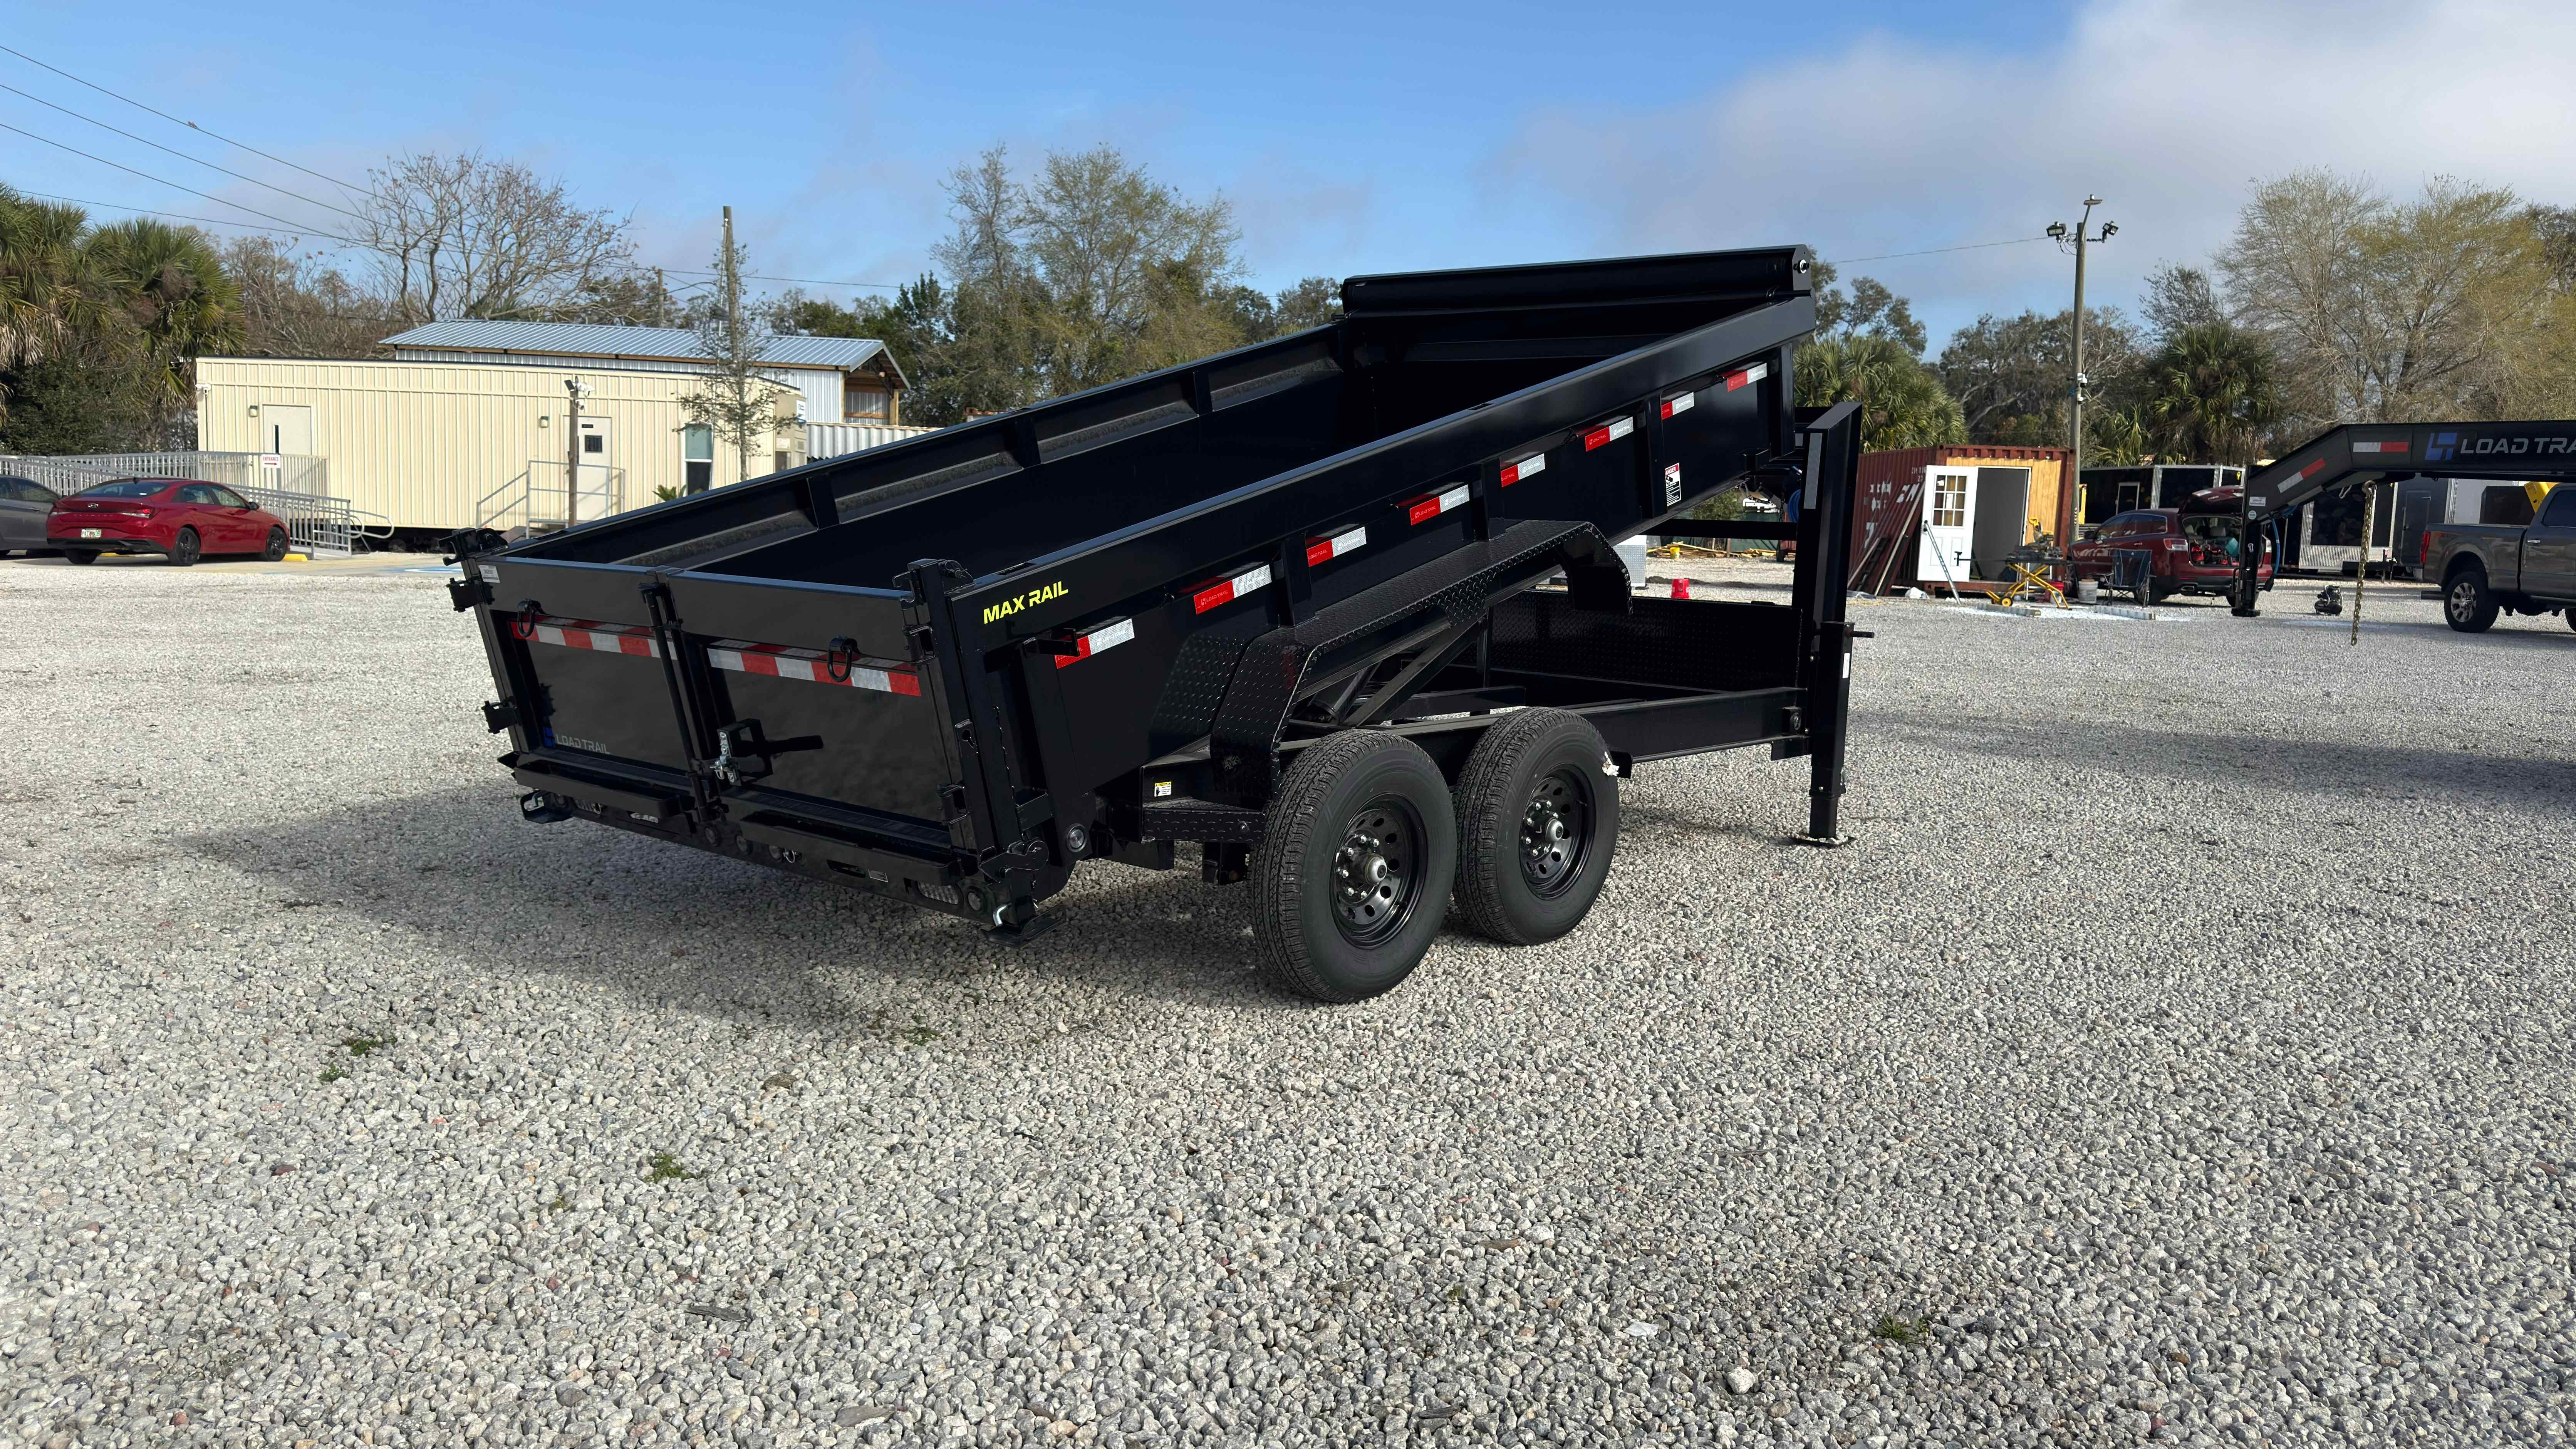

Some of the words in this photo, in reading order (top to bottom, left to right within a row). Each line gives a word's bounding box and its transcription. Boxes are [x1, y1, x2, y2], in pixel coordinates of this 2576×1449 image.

[2460, 438, 2529, 454] LOAD
[1665, 466, 1676, 475] ANGER
[1217, 590, 1228, 598] TRAIL
[983, 595, 1025, 624] MAX
[1029, 581, 1068, 607] RAIL
[555, 733, 581, 748] LOAD
[581, 739, 610, 755] TRAIL
